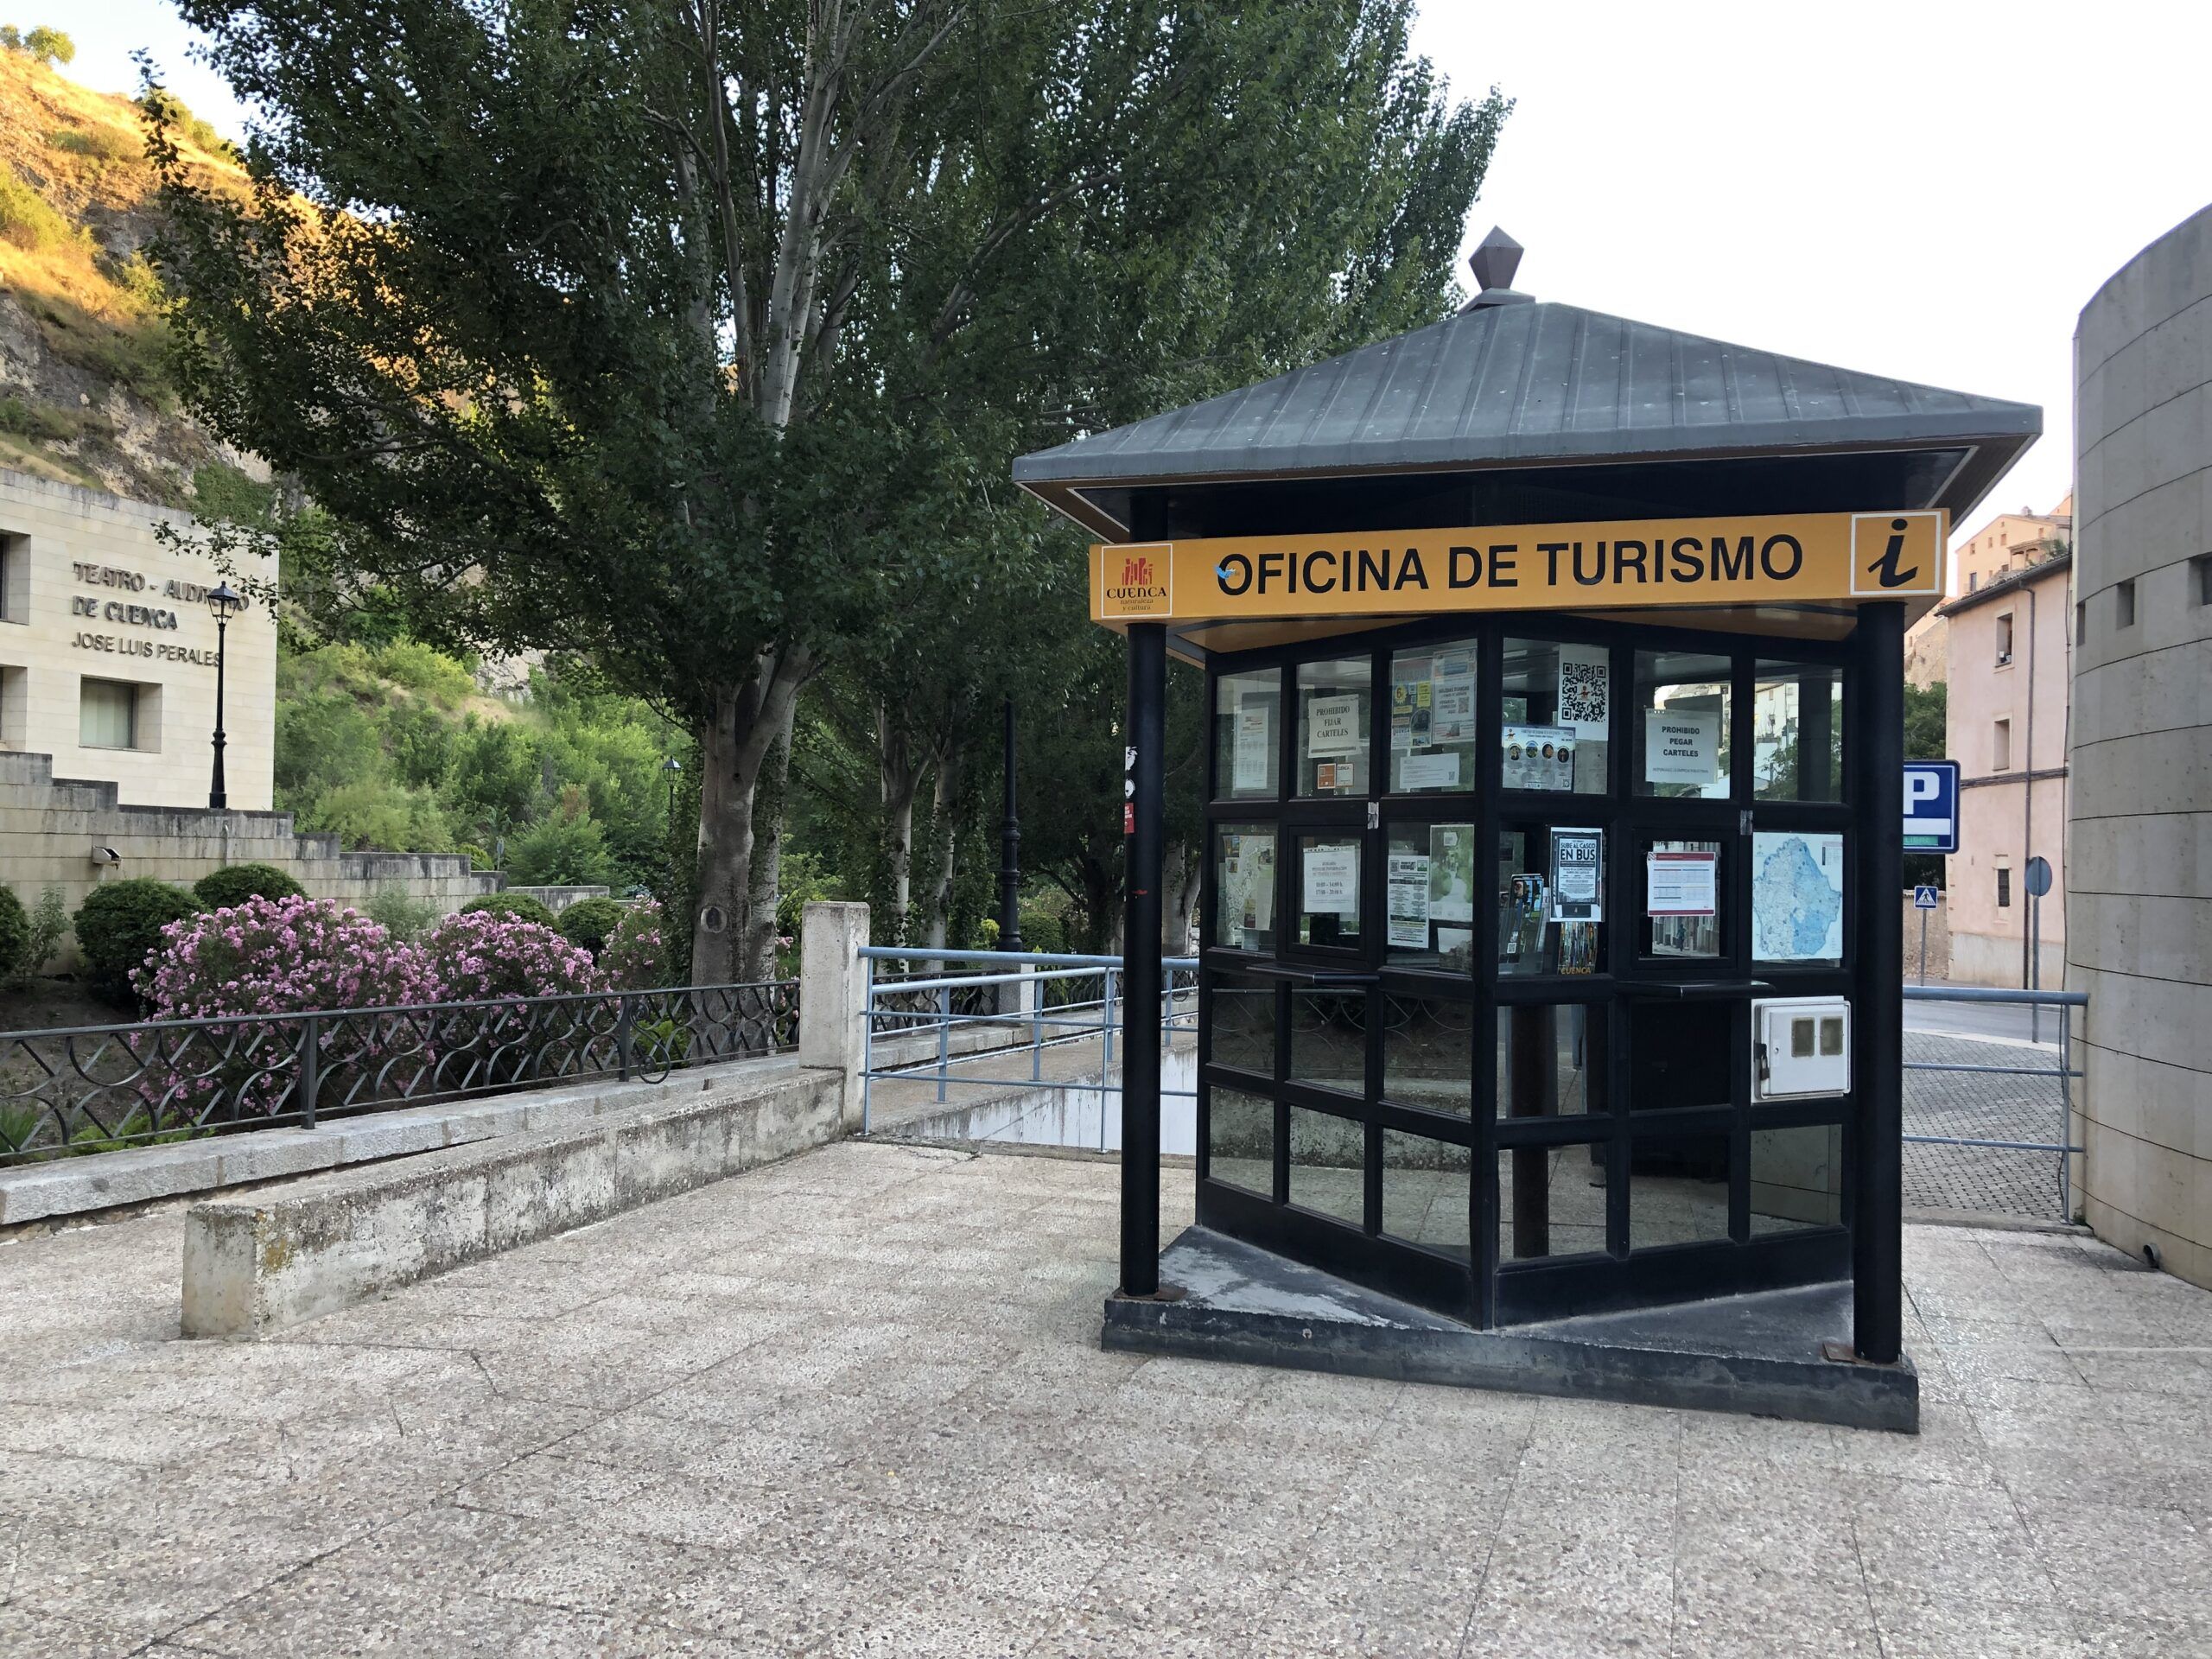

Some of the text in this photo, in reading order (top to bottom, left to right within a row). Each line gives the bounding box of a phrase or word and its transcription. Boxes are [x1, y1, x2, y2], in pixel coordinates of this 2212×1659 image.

[1217, 533, 1803, 596] OFICINA DE TURISMO
[73, 561, 146, 592] TEATRO
[163, 579, 250, 612] AUDITO
[1106, 587, 1166, 599] CUENCA
[73, 594, 178, 631] DE CUENCA
[71, 631, 220, 668] JOSE LUIS PERALES
[1316, 705, 1351, 716] PROHIBIDO
[1324, 717, 1342, 727] FIJAR
[1317, 728, 1349, 738] CARTELES
[1662, 726, 1700, 734] PROHIBIDO
[1662, 748, 1699, 758] CARTELES
[1903, 771, 1940, 815] P
[1560, 849, 1596, 861] EN BUS
